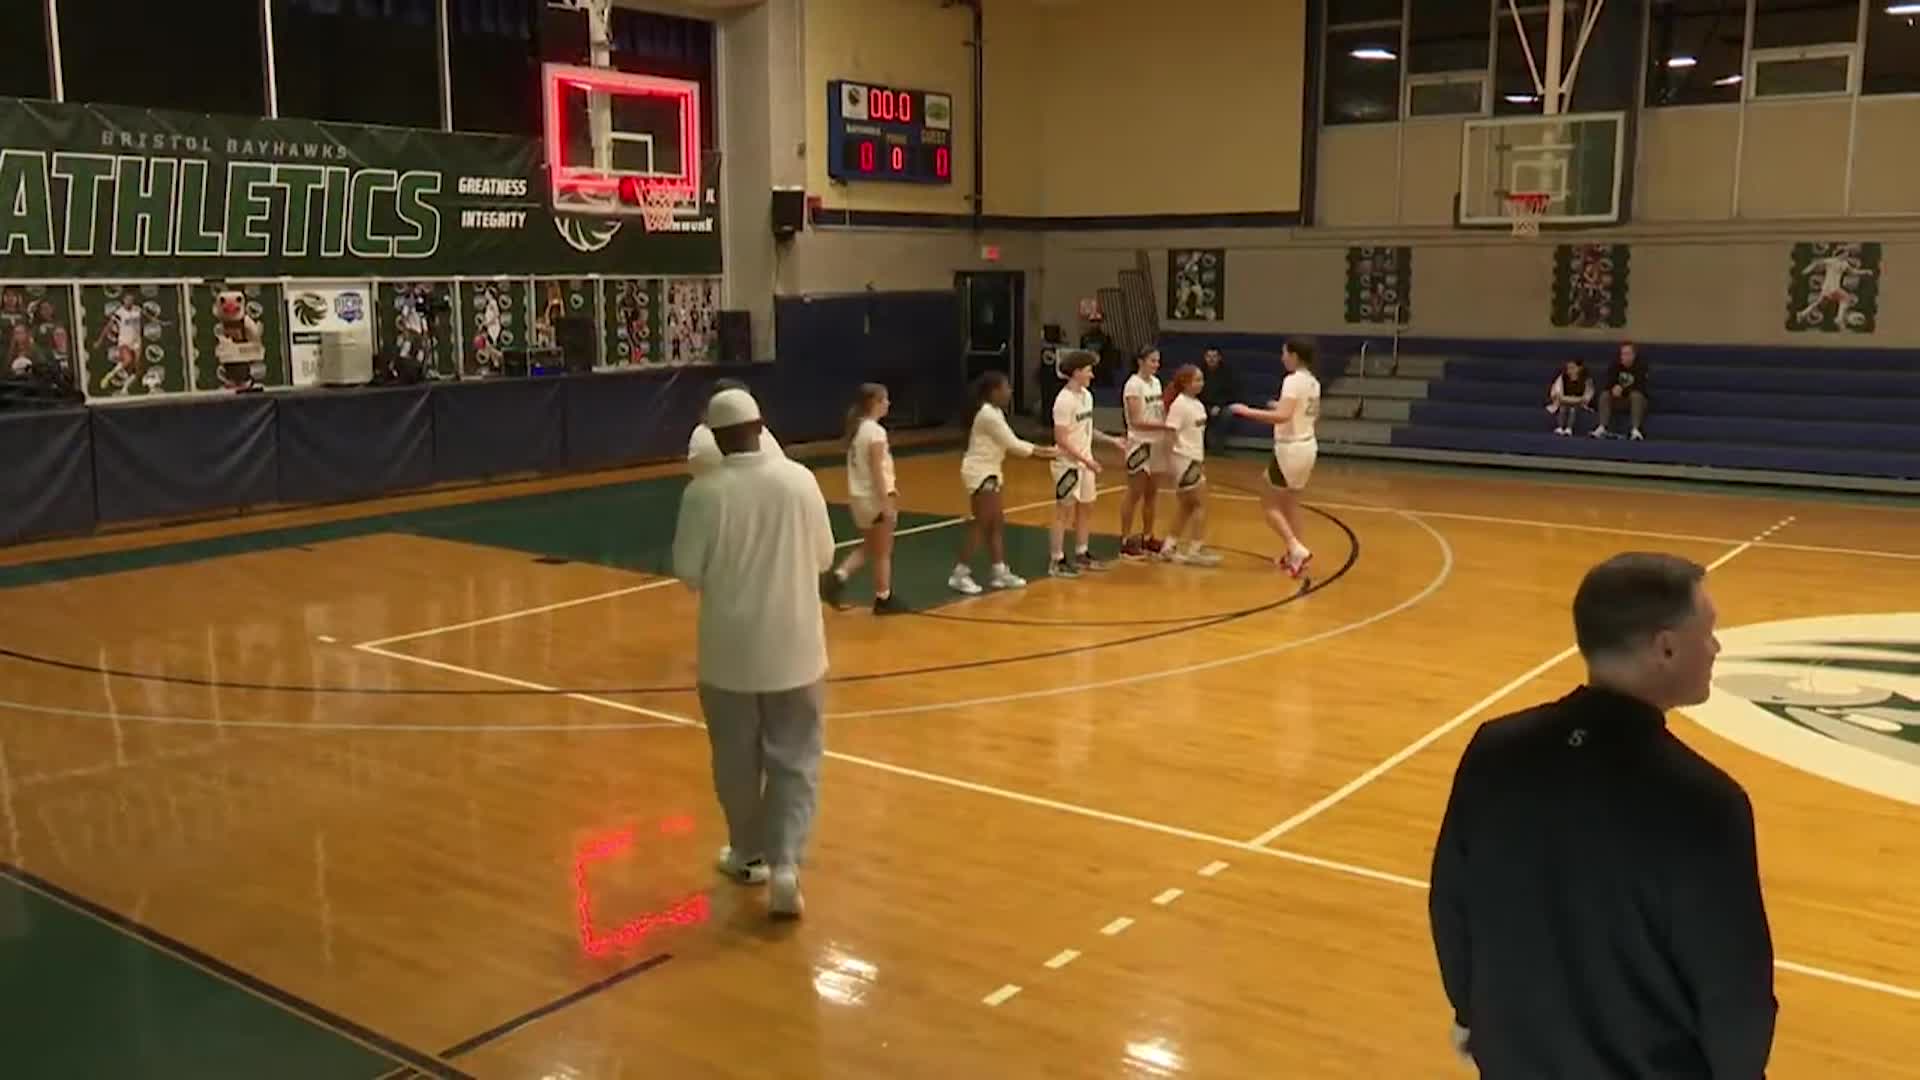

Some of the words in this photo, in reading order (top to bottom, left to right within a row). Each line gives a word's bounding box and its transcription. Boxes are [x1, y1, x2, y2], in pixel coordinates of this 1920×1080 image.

[870, 88, 911, 122] 00.0
[101, 129, 212, 152] BRISTOL
[226, 138, 349, 159] BAYHAWKS
[458, 176, 527, 197] GREATNESS
[0, 149, 442, 259] ATHLETICS
[461, 210, 527, 229] INTEGRITY
